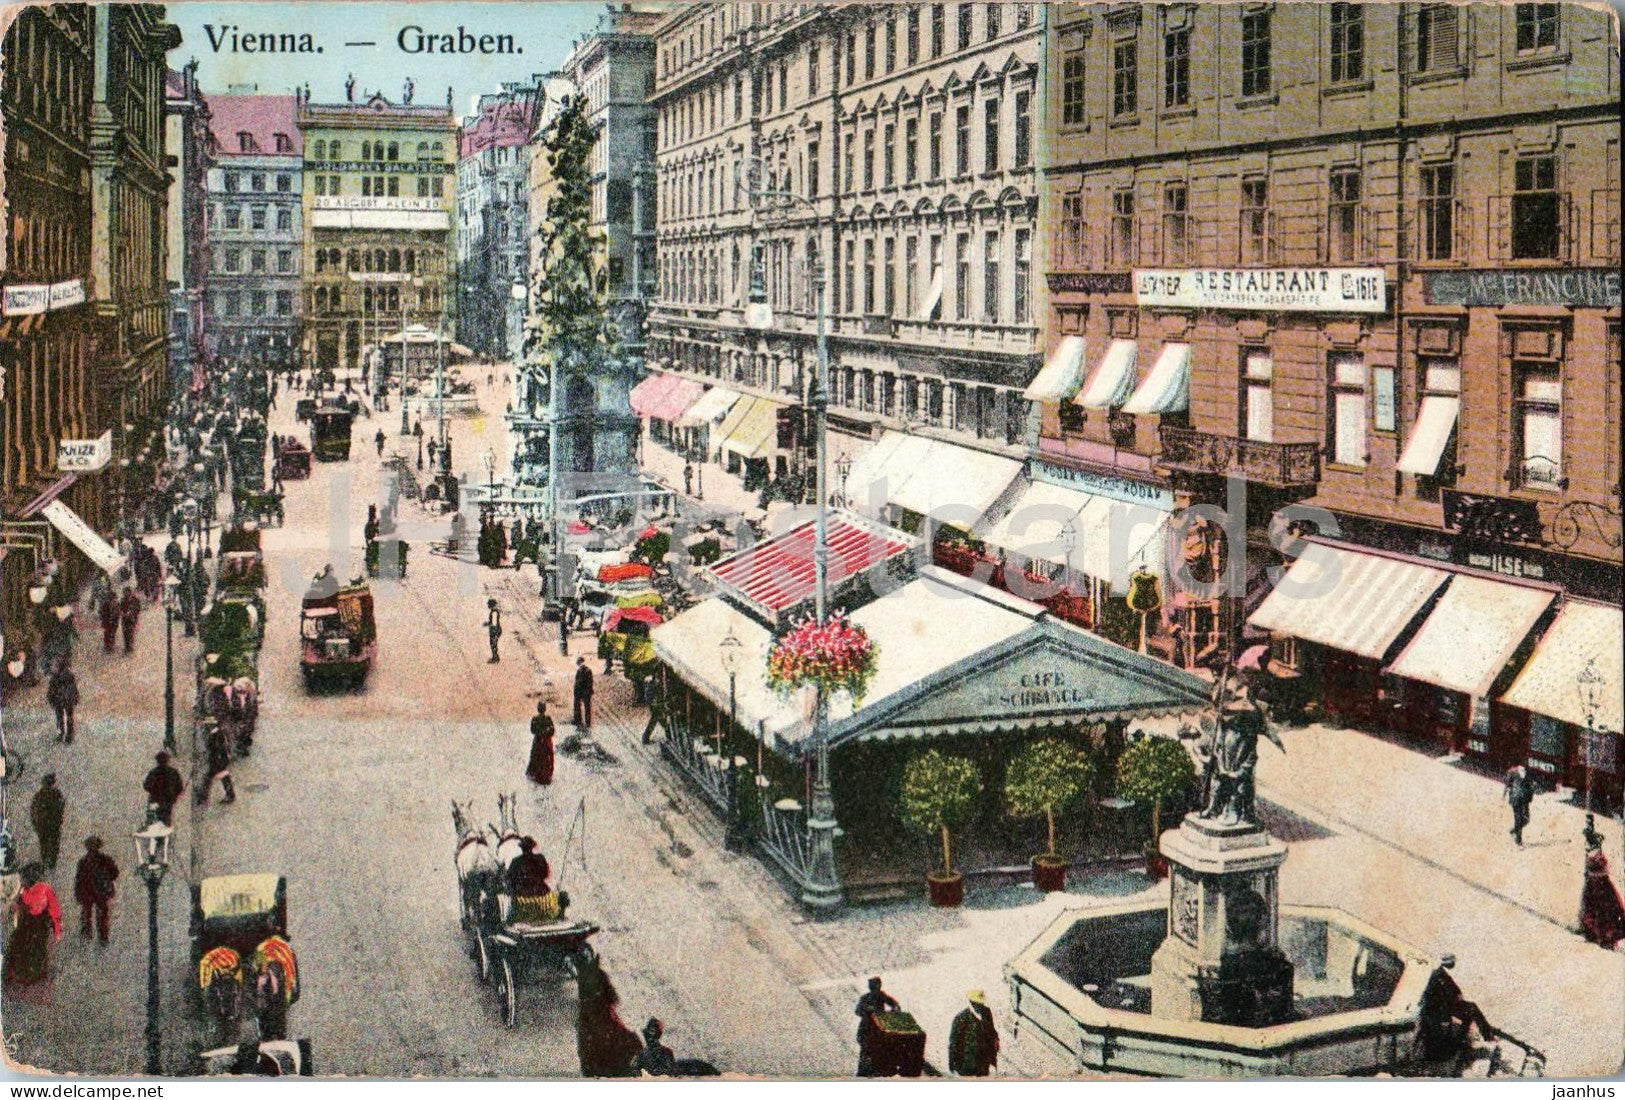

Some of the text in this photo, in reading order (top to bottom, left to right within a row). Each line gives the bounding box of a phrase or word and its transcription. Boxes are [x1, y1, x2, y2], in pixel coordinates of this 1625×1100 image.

[1196, 270, 1330, 292] RESTAURANT
[1502, 272, 1621, 302] FRANCINE
[1492, 553, 1522, 577] ILSE
